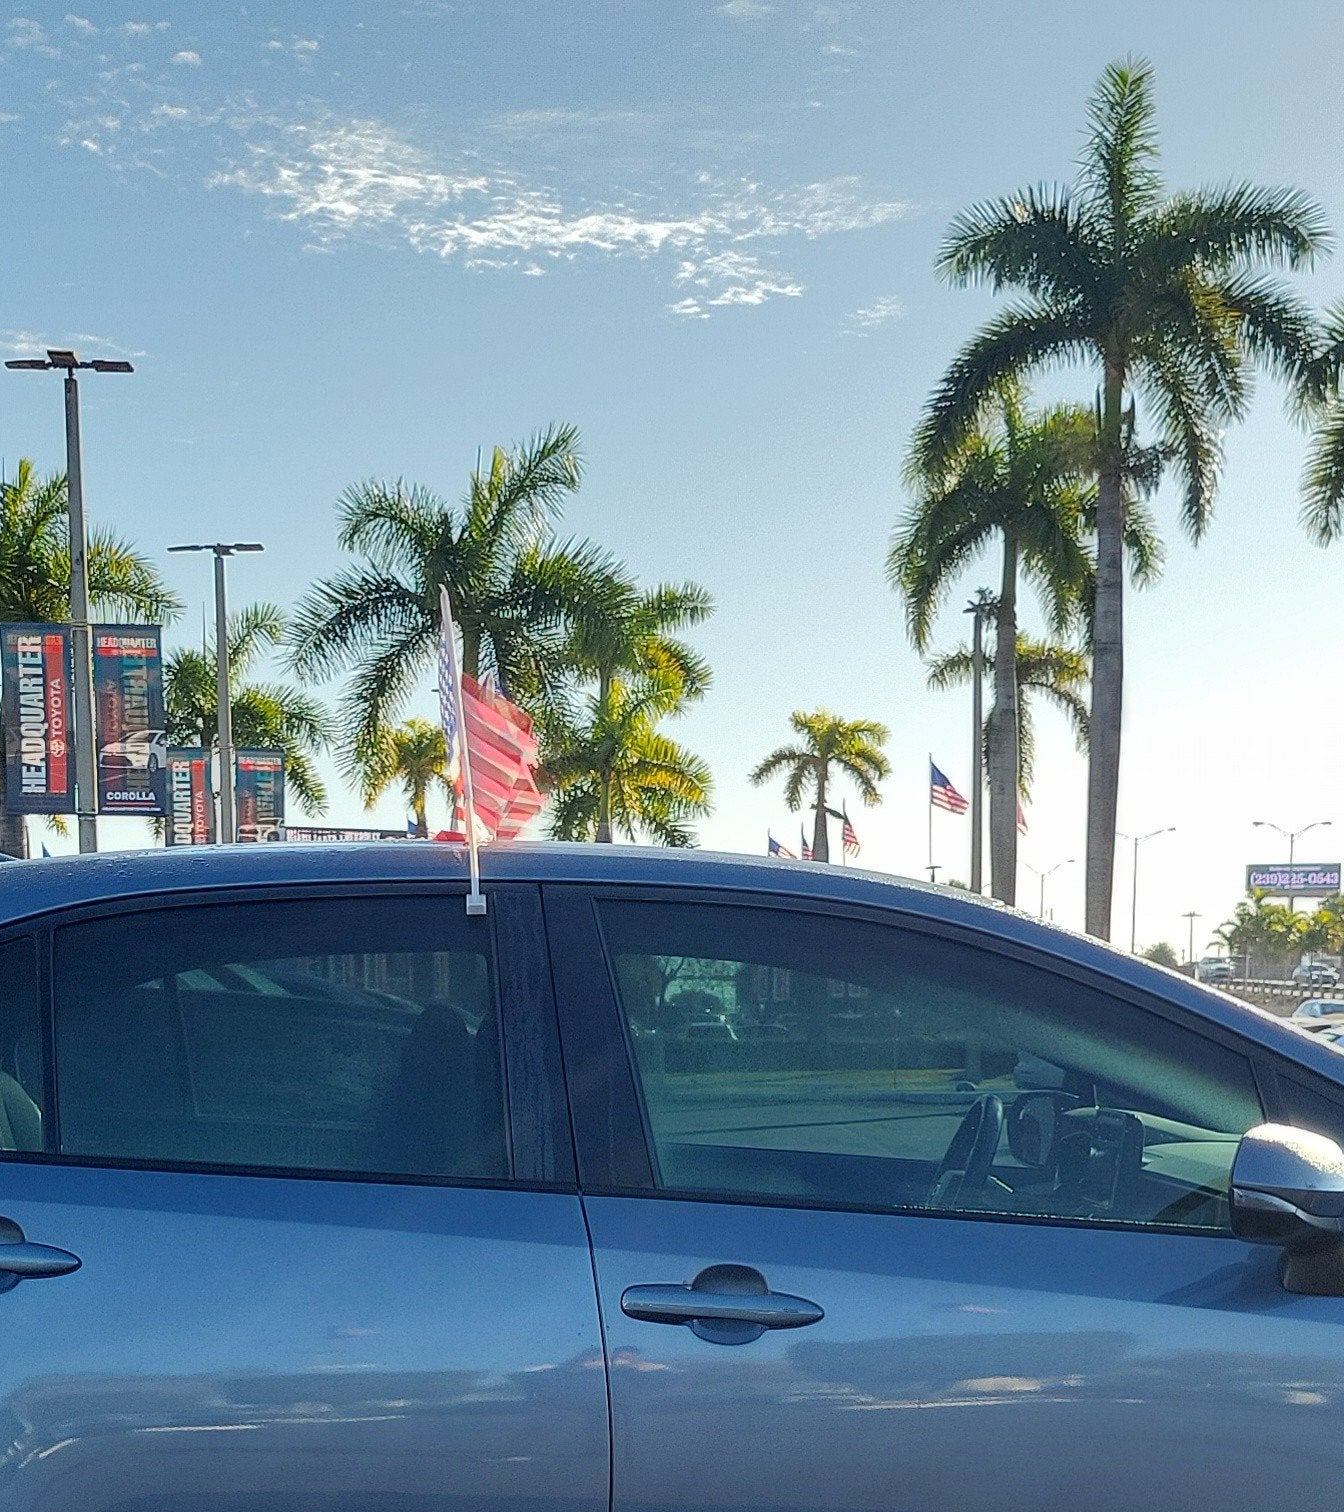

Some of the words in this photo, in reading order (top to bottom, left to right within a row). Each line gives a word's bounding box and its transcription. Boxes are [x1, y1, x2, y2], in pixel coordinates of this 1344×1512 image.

[18, 635, 47, 794] HEADQUARTER
[50, 678, 64, 737] TOYOTA
[107, 791, 155, 801] COROLLA
[196, 791, 205, 832] TOYOTA
